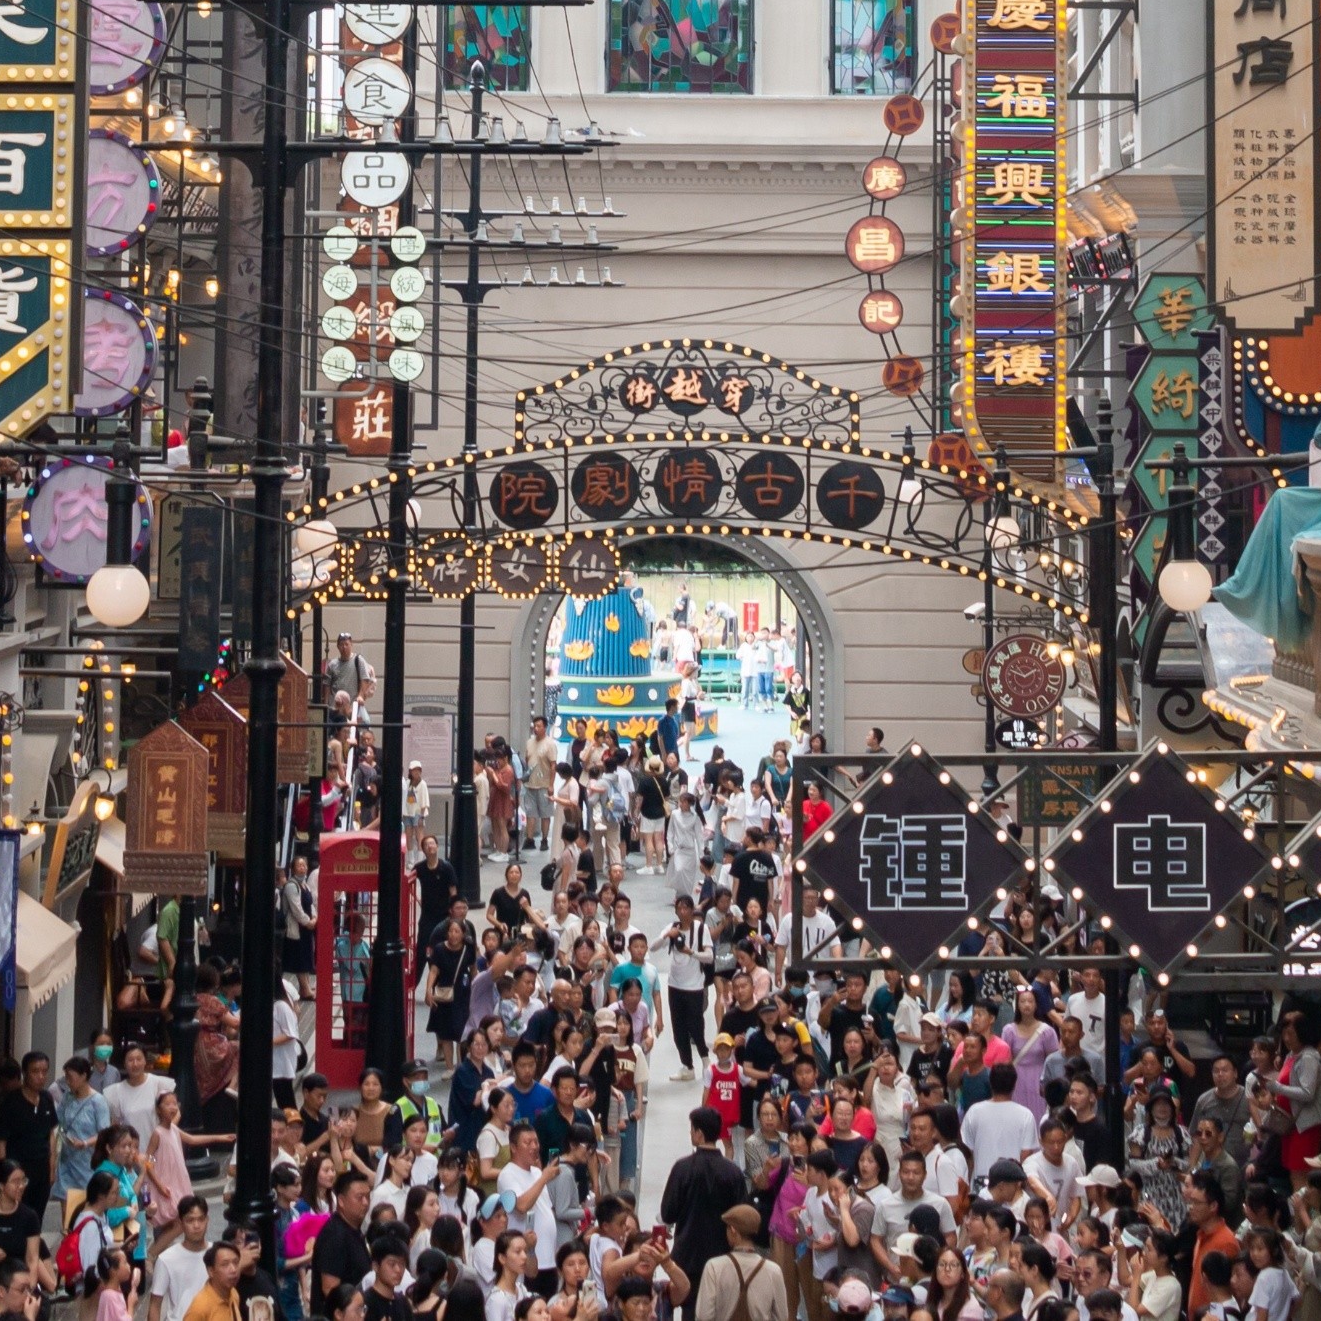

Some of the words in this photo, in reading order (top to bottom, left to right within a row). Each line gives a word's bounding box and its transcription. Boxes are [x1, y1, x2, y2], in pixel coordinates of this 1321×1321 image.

[855, 165, 902, 325] 廣昌記
[626, 368, 751, 413] 穿越街
[499, 456, 880, 519] 千古情劇院
